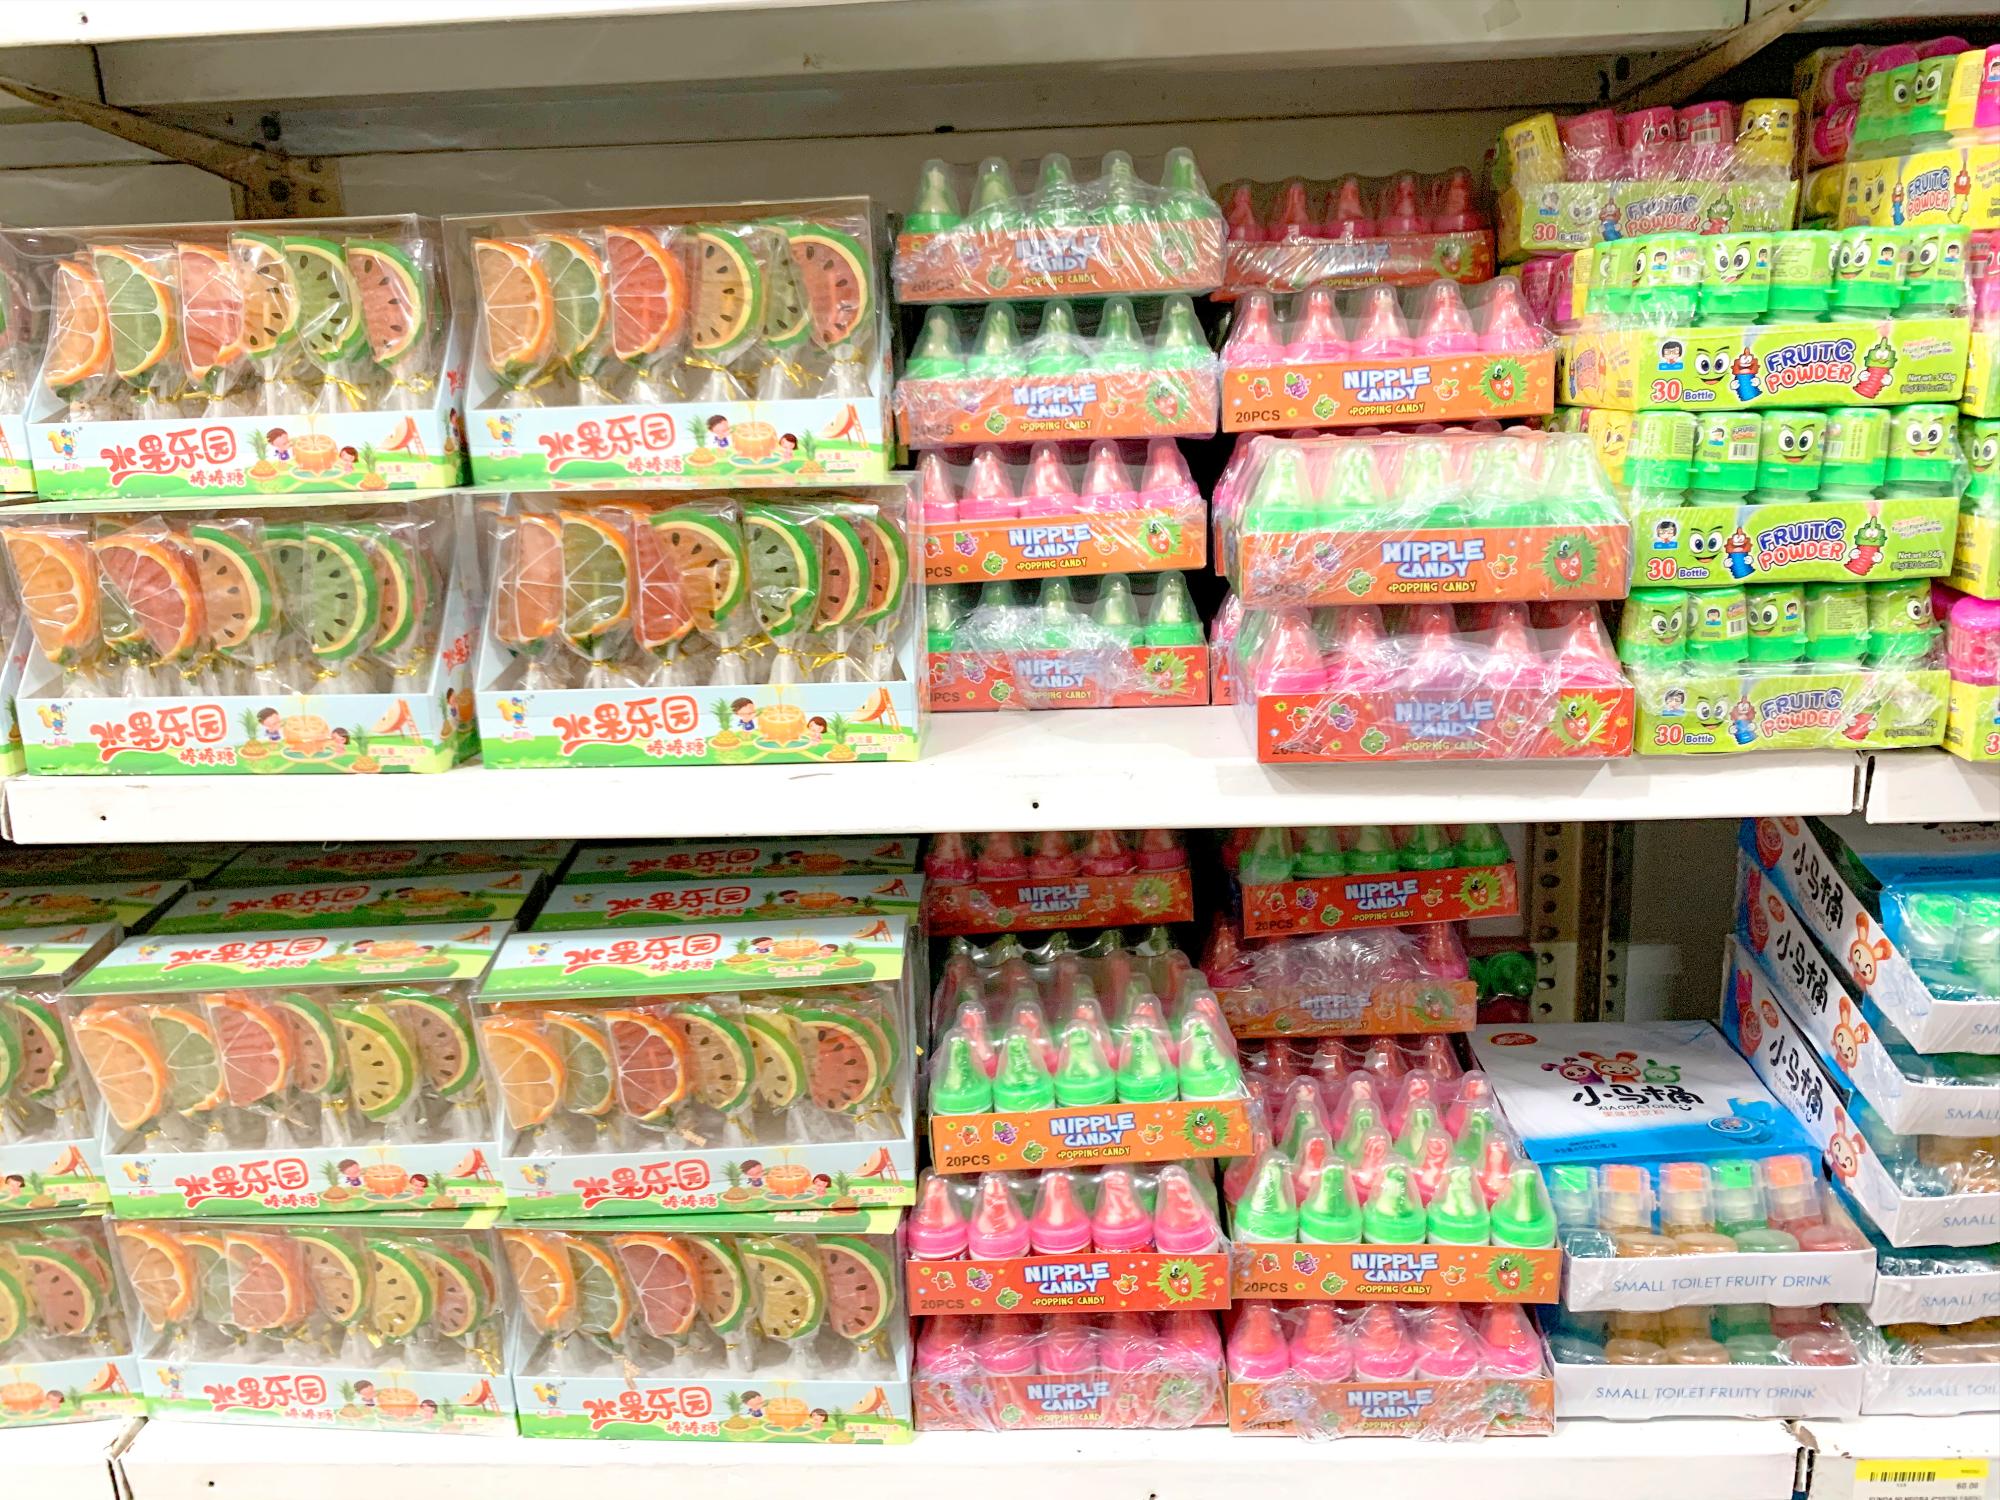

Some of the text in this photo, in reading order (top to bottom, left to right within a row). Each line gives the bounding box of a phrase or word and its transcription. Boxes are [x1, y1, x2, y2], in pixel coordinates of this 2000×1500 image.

[1907, 166, 1950, 199] FRUITC
[1906, 190, 1949, 220] POWDER
[1534, 224, 1557, 242] 30
[1028, 255, 1088, 272] CANDY
[1068, 272, 1096, 284] CANDY
[1766, 339, 1855, 374] FRUITC
[1343, 366, 1431, 389] NIPPLE
[1766, 364, 1853, 393] POWDER
[1012, 384, 1098, 406] NIPPLE
[1356, 385, 1418, 402] CANDY
[1650, 380, 1715, 402] 30 Bottle
[1026, 402, 1085, 418] CANDY
[1236, 410, 1280, 423] 20PCS
[1395, 402, 1425, 413] CANDY
[1064, 420, 1091, 431] CANDY
[538, 414, 676, 470] 水果乐园
[101, 427, 236, 485] 水果乐园
[628, 455, 684, 473] 棒棒糖
[190, 468, 245, 486] 棒棒糖
[1008, 524, 1091, 546] NIPPLE
[1759, 518, 1846, 550] FRUITC
[1021, 543, 1080, 558] CANDY
[1382, 539, 1486, 563] NIPPLE
[1758, 541, 1846, 570] POWDER
[926, 567, 953, 578] PCS
[1060, 558, 1087, 569] CANDY
[1397, 560, 1470, 578] CANDY
[1648, 558, 1709, 579] 30 Bottle
[1442, 580, 1477, 592] CANDY
[1029, 675, 1084, 688] CANDY
[932, 691, 960, 704] PCS
[1065, 690, 1091, 699] CANDY
[1394, 700, 1495, 722] NIPPLE
[1760, 689, 1844, 719] FRUITC
[552, 696, 699, 755] 水果乐园
[1409, 721, 1479, 736] CANDY
[1761, 710, 1842, 737] POWDER
[90, 705, 227, 761] 水果乐园
[1655, 725, 1714, 744] 30 Bottle
[647, 738, 706, 756] 棒棒糖
[1985, 732, 2000, 755] 3
[180, 747, 236, 765] 棒棒糖
[1017, 884, 1090, 903] NIPPLE
[1345, 880, 1418, 899] NIPPLE
[606, 886, 752, 919] 水果乐园
[1030, 899, 1080, 912] CANDY
[1356, 896, 1408, 910] CANDY
[1390, 910, 1415, 919] CANDY
[1255, 920, 1293, 931] 20PCS
[161, 936, 328, 972] 水果乐园
[563, 933, 721, 974] 水果乐园
[1312, 1008, 1362, 1020] CANDY
[1050, 1113, 1136, 1136] NIPPLE
[1063, 1131, 1124, 1147] CANDY
[1102, 1146, 1130, 1157] CANDY
[946, 1155, 990, 1167] 20PCS
[175, 1158, 310, 1208] 水果乐园
[572, 1159, 711, 1210] 水果乐园
[264, 1193, 318, 1209] 棒棒糖
[661, 1194, 719, 1209] 棒棒糖
[1943, 1215, 1996, 1228] SMALL
[1351, 1253, 1439, 1272] NIPPLE
[1024, 1263, 1110, 1283] NIPPLE
[1364, 1268, 1424, 1283] CANDY
[1038, 1279, 1100, 1294] CANDY
[1244, 1282, 1288, 1293] 20PCS
[1402, 1285, 1431, 1294] CANDY
[1613, 1274, 1831, 1292] SMALL TOILET FRUITY DRINK
[921, 1299, 965, 1310] 20PCS
[1077, 1296, 1105, 1305] CANDY
[1921, 1296, 1974, 1308] SMALL
[203, 1375, 326, 1412] 水果乐园
[1027, 1381, 1111, 1400] NIPPLE
[1347, 1388, 1433, 1407] NIPPLE
[1596, 1386, 1816, 1399] SMALL TOILET FRUITY DRINK
[1907, 1385, 2000, 1397] SMALL TOIL
[582, 1387, 712, 1430] 水果乐园
[1041, 1397, 1098, 1411] CANDY
[1361, 1405, 1420, 1418] CANDY
[666, 1422, 720, 1436] 棒棒糖
